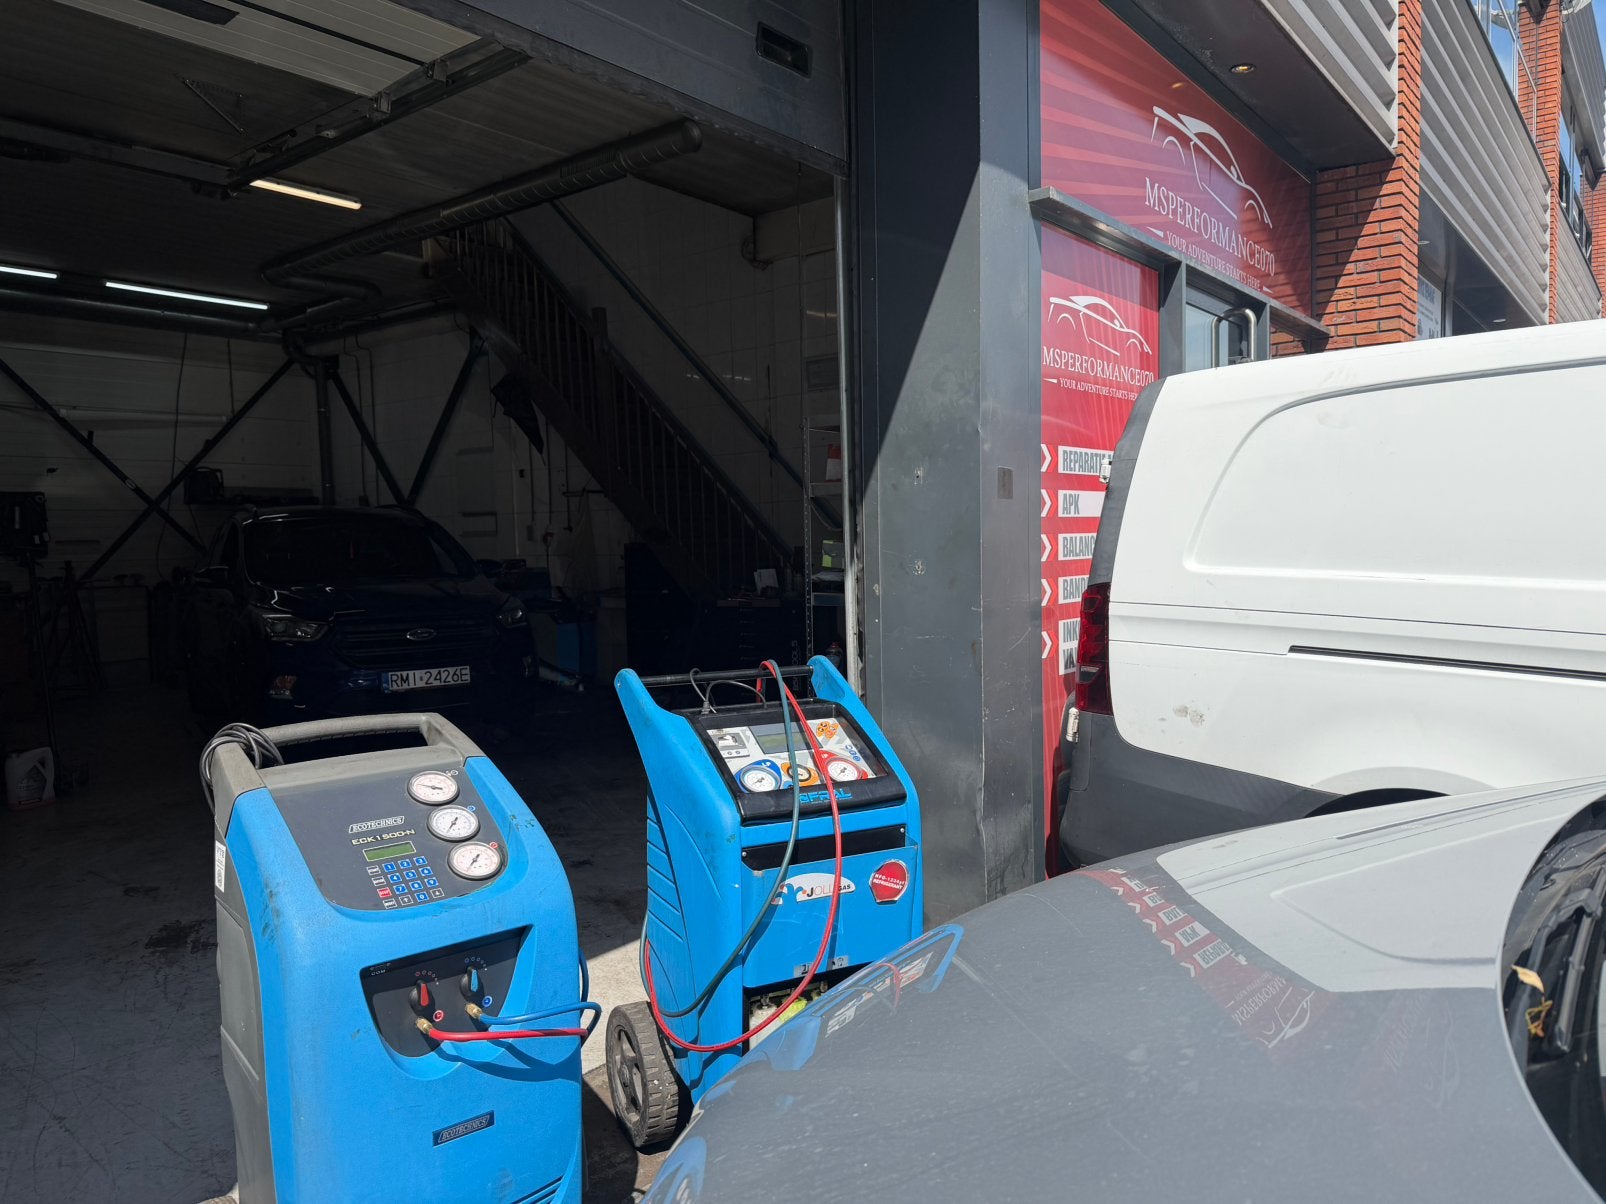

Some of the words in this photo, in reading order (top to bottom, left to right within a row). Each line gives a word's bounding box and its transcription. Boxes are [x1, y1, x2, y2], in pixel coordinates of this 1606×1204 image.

[1145, 177, 1275, 276] MSPERFORMANCE070
[1167, 231, 1187, 253] YOUR
[1188, 244, 1226, 272] ADVENTURE
[1226, 260, 1247, 284] STARTS
[1247, 272, 1261, 290] HERE
[1060, 378, 1076, 390] YOUR
[1077, 381, 1109, 396] ADVENTURE
[1110, 388, 1128, 401] STARTS
[1062, 493, 1080, 515] APK
[390, 672, 417, 688] RMI
[424, 668, 469, 685] 2426E
[353, 816, 402, 832] ECOTECHNICS
[442, 1117, 488, 1140] ECOTECHNICS
